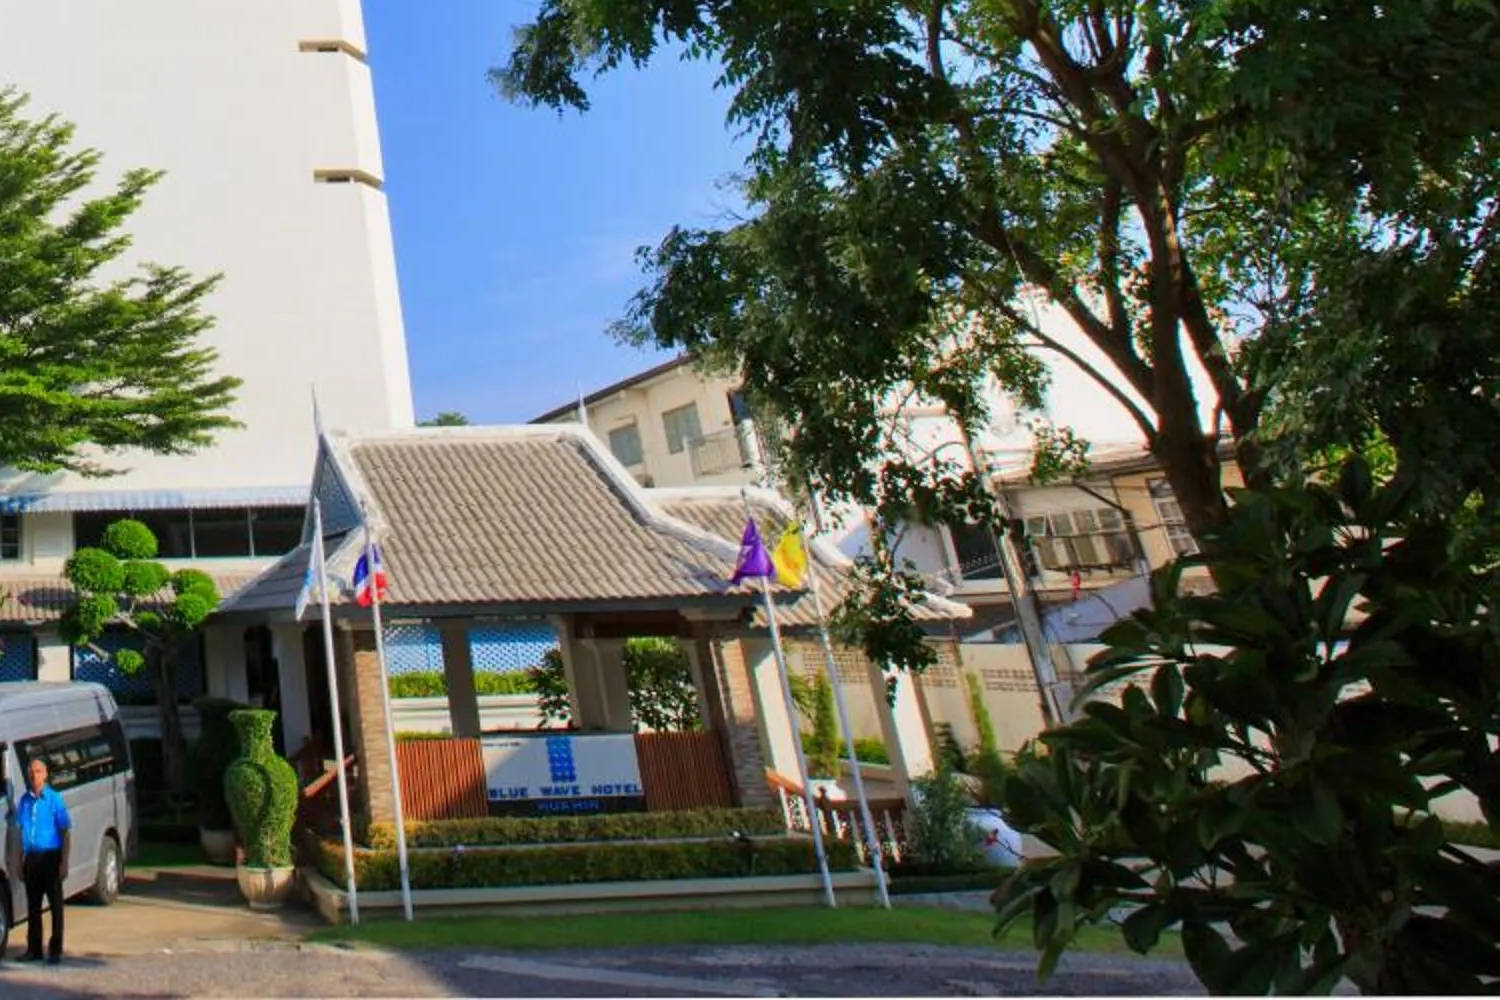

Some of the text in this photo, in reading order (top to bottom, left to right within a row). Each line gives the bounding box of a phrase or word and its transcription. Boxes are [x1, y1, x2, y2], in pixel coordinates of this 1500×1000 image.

[488, 783, 642, 799] BLUE WAVE HOTEL
